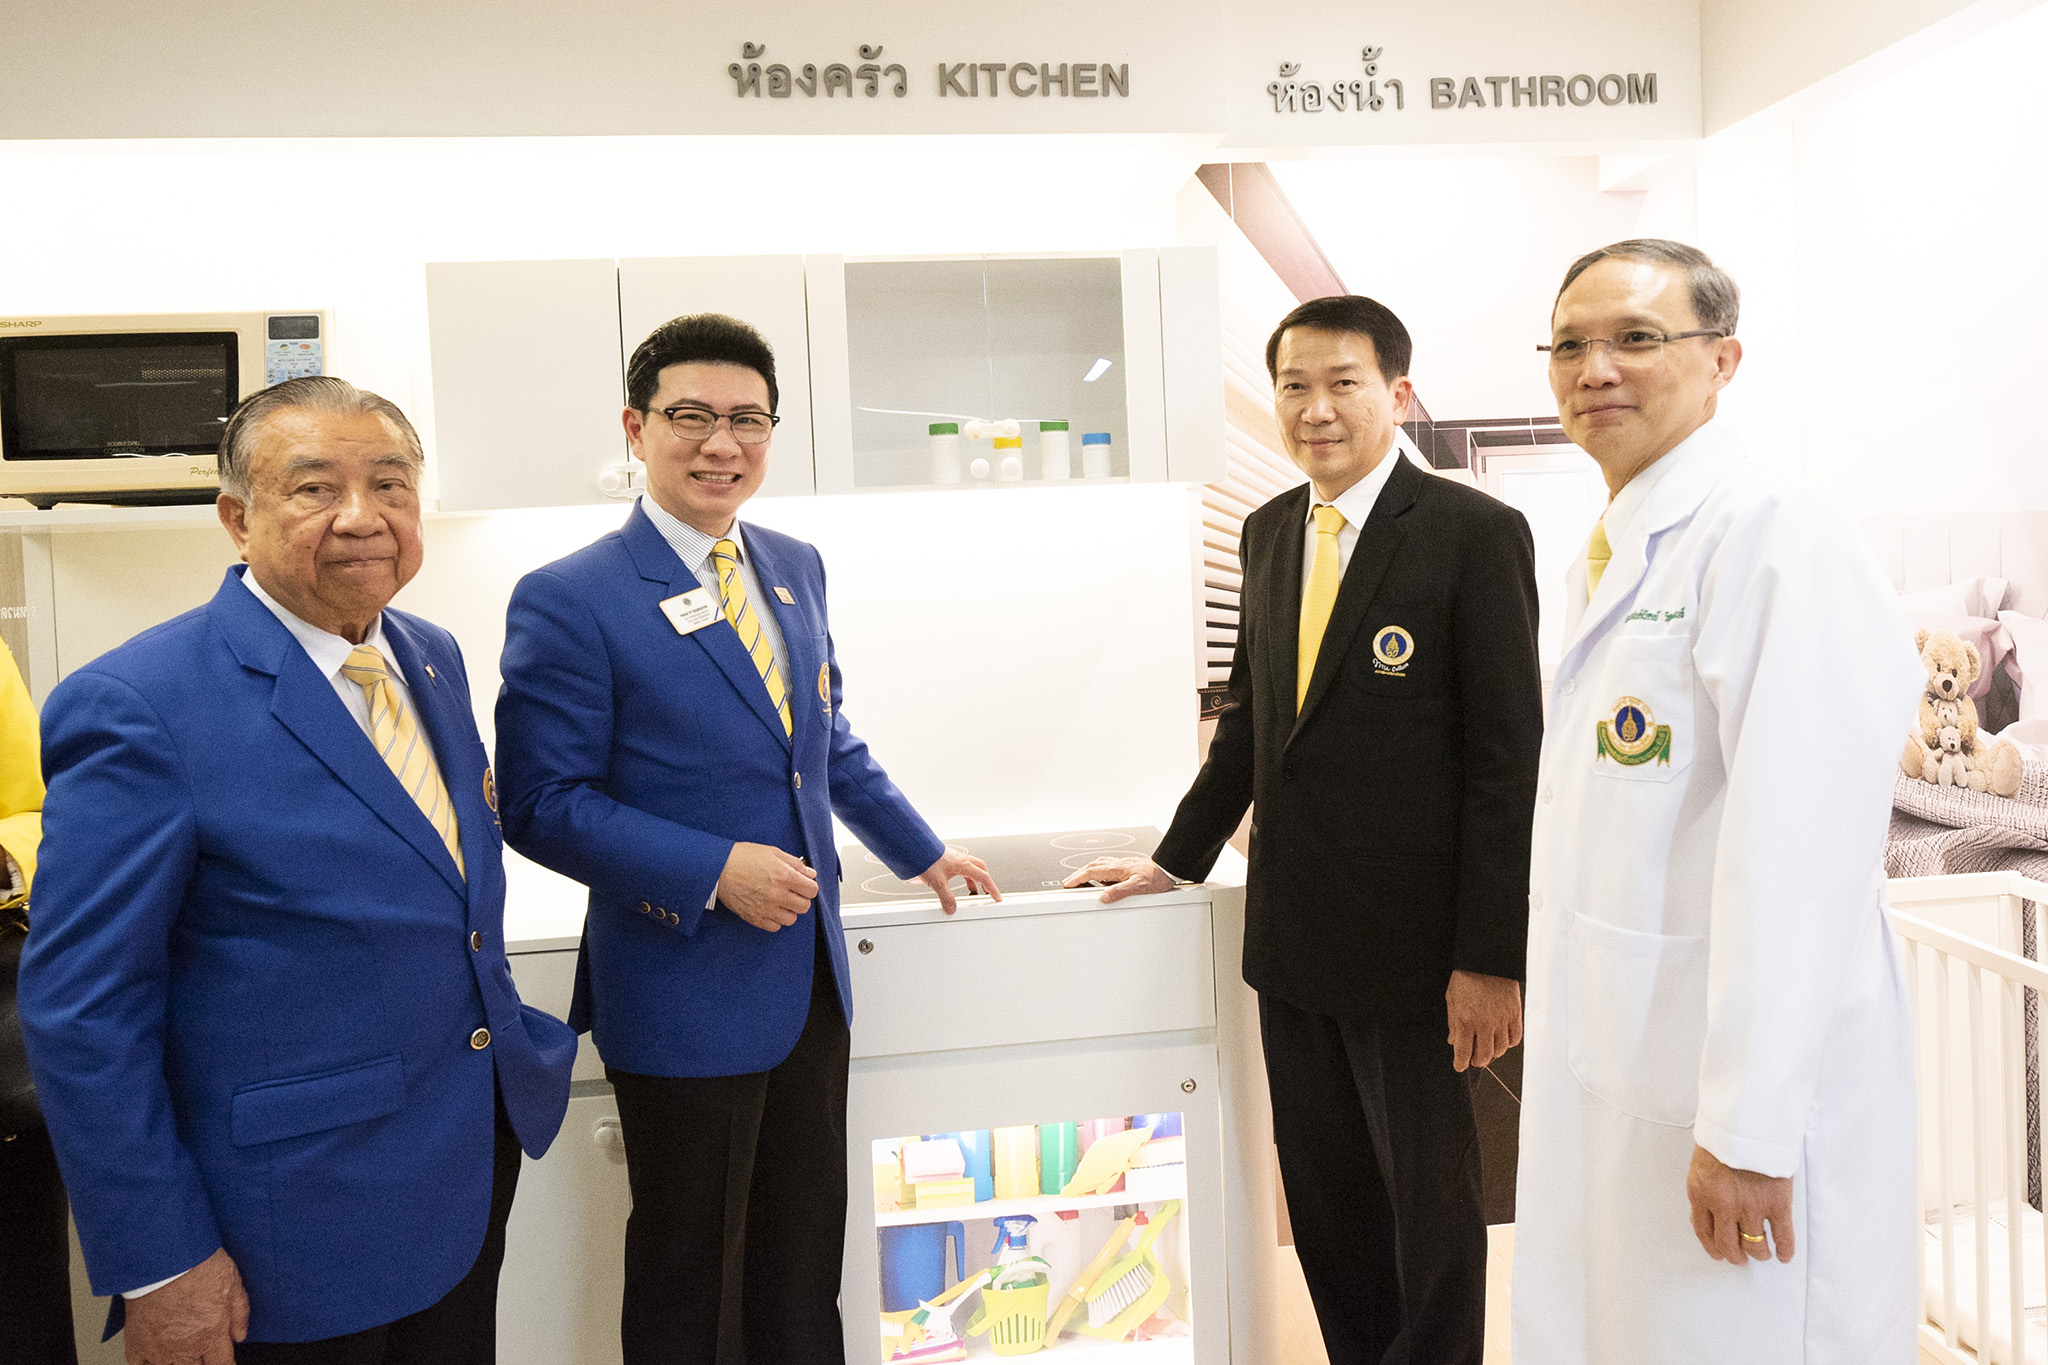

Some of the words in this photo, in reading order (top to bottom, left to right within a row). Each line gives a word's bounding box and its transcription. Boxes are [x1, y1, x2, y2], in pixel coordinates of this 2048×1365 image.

[728, 41, 908, 99] ห้องครัว
[939, 62, 1130, 98] KITCHEN
[1267, 44, 1405, 113] ห้องน้ำ
[1429, 72, 1658, 110] BATHROOM
[0, 320, 42, 328] SHARP
